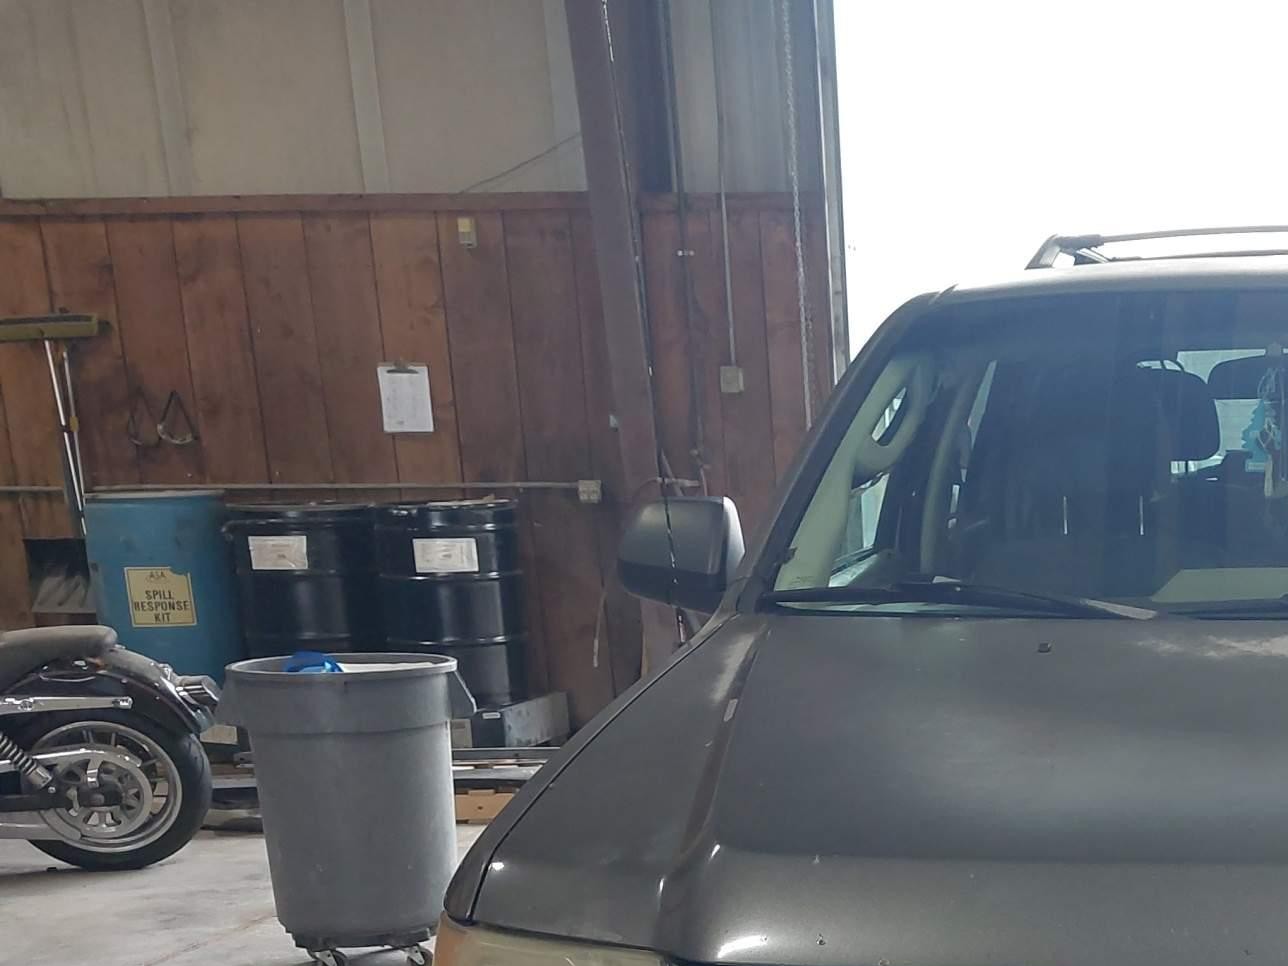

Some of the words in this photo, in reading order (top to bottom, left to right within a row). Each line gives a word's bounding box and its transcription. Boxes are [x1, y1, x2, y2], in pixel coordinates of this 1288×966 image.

[144, 590, 174, 600] SPILL
[134, 600, 191, 612] RESPONSE
[153, 612, 172, 622] KIT
